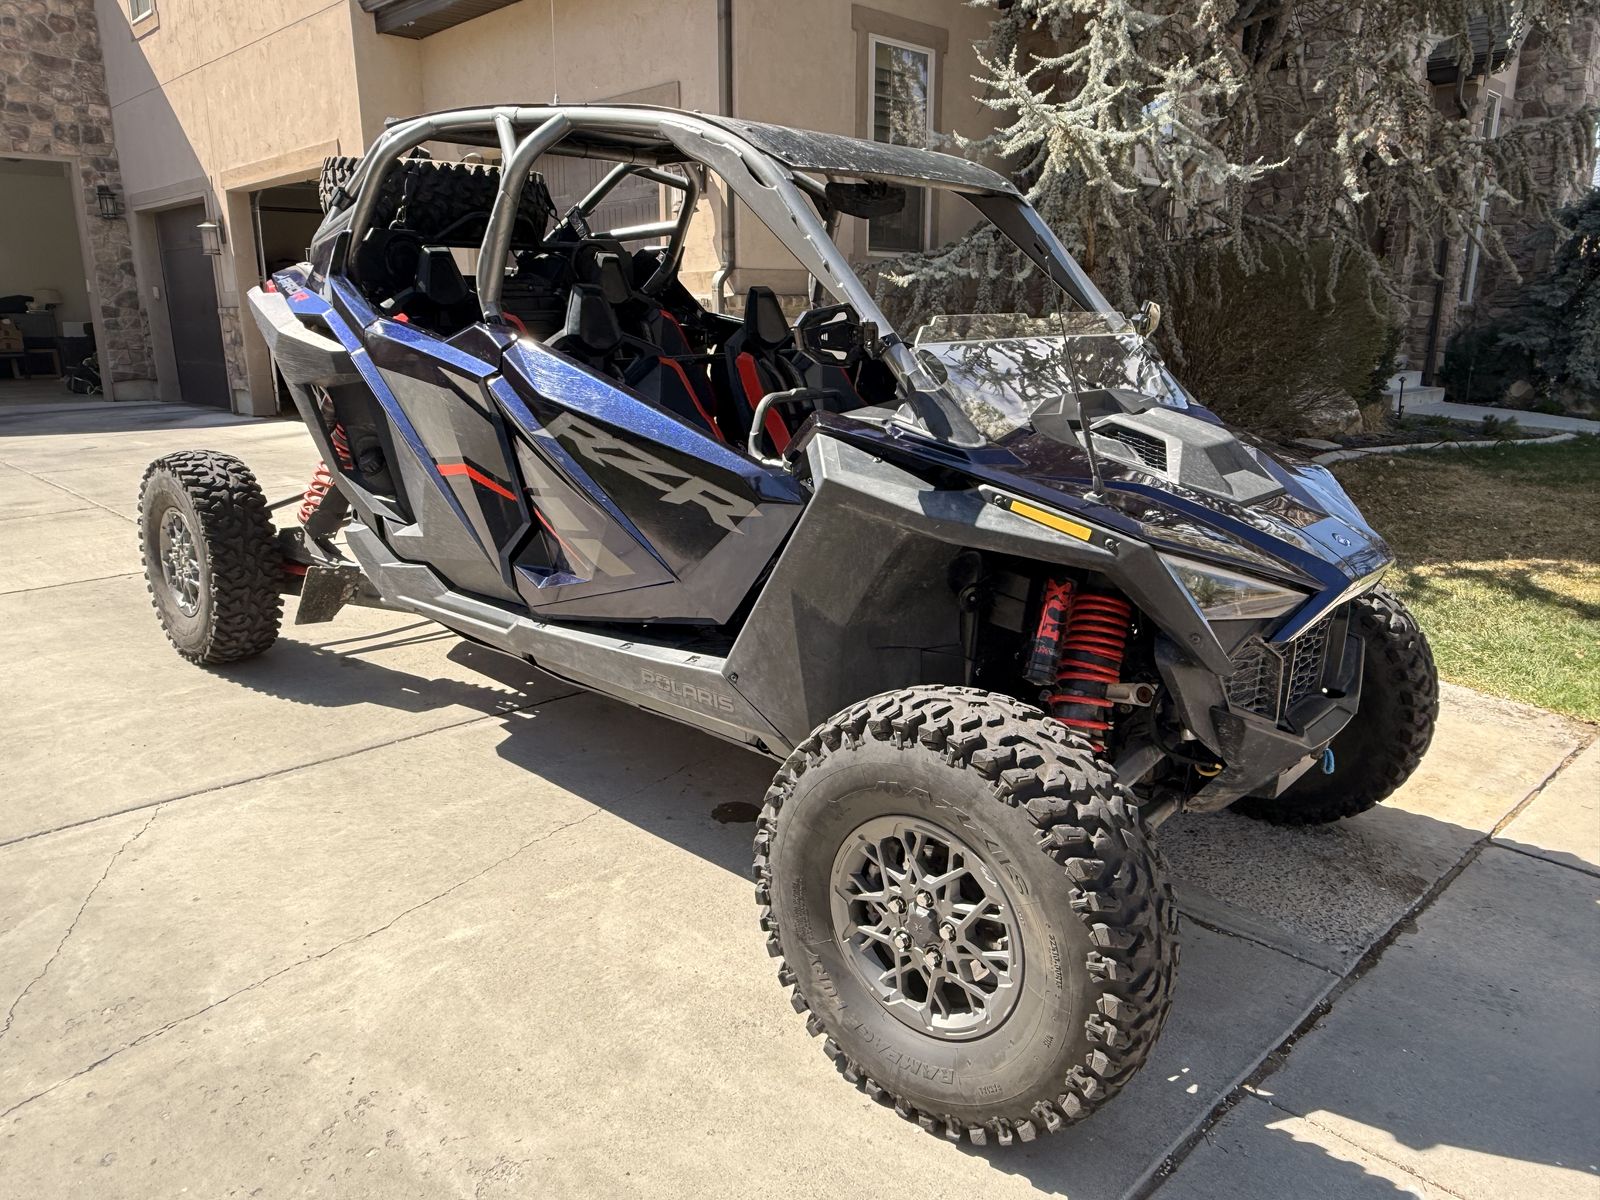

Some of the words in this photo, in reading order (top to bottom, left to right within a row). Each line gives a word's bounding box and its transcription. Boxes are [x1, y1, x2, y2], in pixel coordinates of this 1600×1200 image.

[530, 411, 763, 535] RZR
[1036, 577, 1072, 641] FOX
[640, 667, 736, 713] POLARIS
